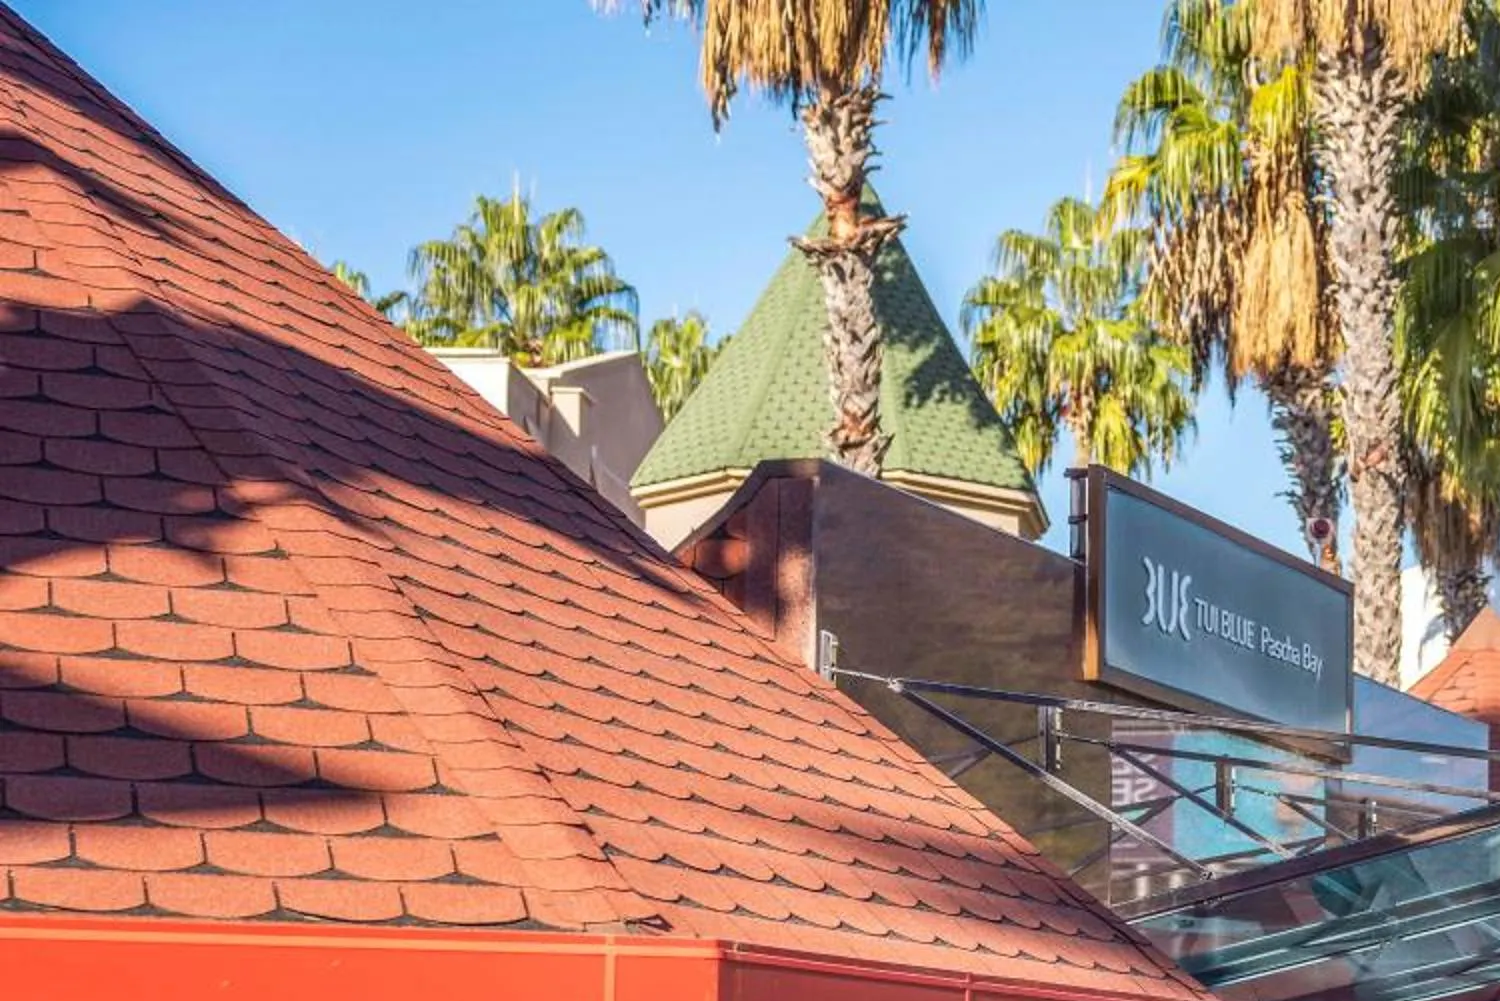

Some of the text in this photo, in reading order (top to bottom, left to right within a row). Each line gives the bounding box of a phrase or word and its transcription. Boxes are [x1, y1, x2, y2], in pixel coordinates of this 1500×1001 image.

[1194, 597, 1219, 633] TUI
[1221, 609, 1255, 649] BLUE
[1302, 643, 1323, 682] Bay
